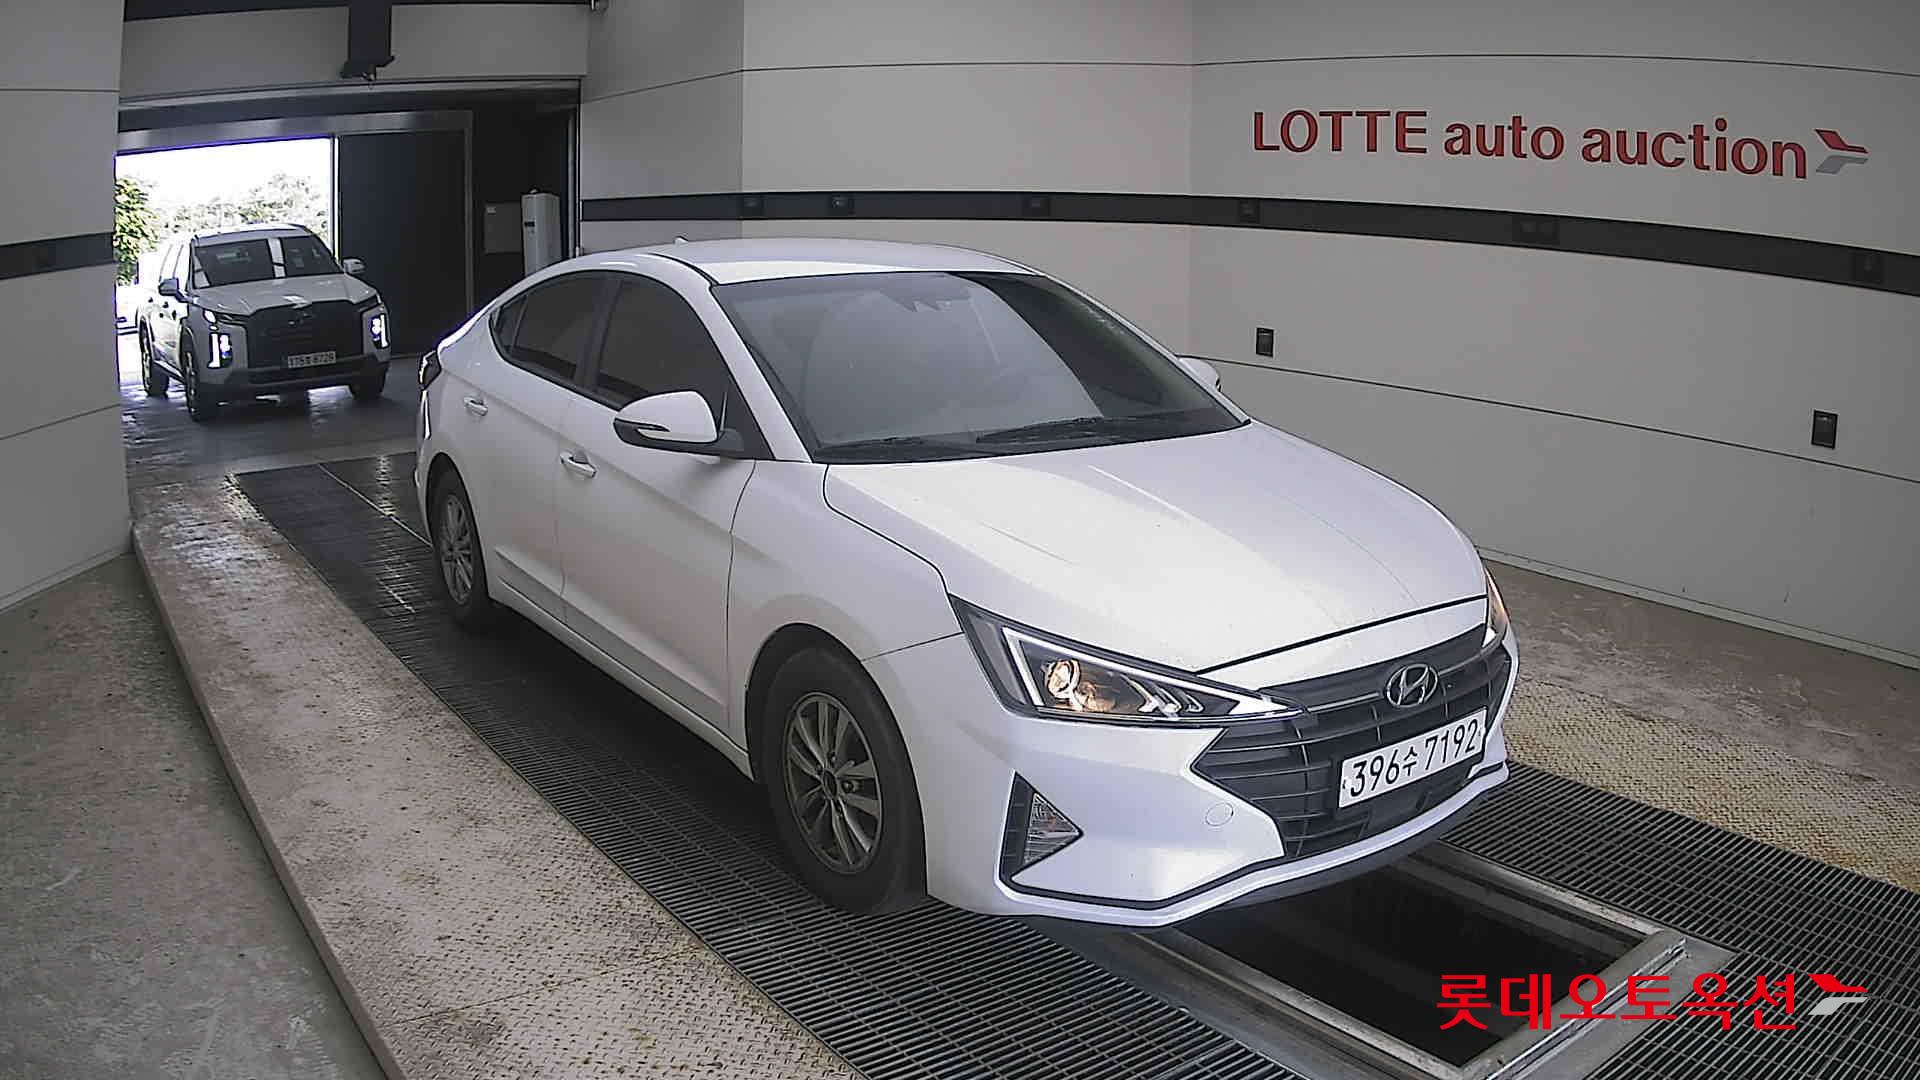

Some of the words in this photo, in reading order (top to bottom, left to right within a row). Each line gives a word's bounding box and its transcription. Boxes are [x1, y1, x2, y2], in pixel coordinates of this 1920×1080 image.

[1254, 111, 1427, 153] LOTTE
[1444, 116, 1565, 160] auto
[1582, 119, 1807, 178] auction
